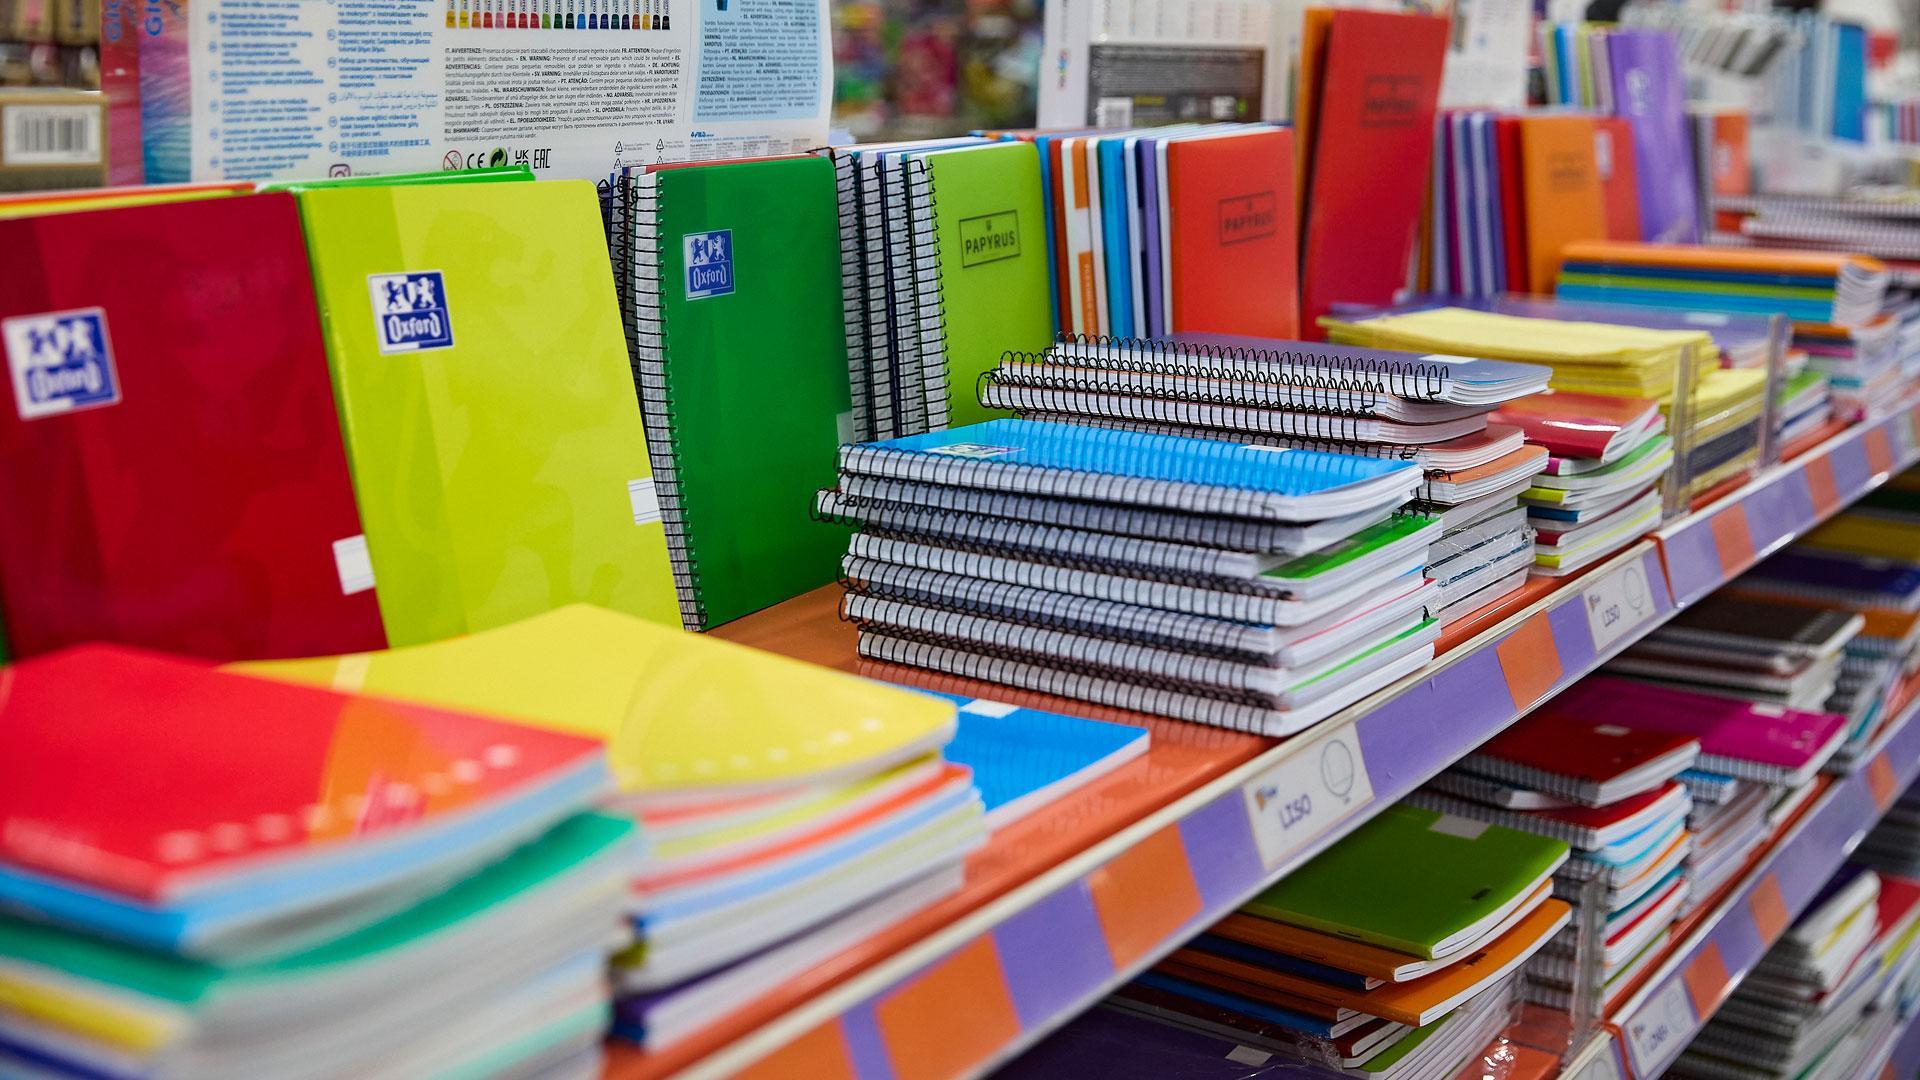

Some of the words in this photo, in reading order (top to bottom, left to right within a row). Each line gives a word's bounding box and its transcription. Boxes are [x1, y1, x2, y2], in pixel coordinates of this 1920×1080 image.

[515, 150, 529, 159] UK
[534, 148, 552, 169] EAC
[965, 230, 1015, 255] PAPYRUS
[693, 264, 727, 289] Oxford
[388, 312, 442, 342] Oxford
[1602, 604, 1621, 628] LISO
[1279, 793, 1312, 830] LISO
